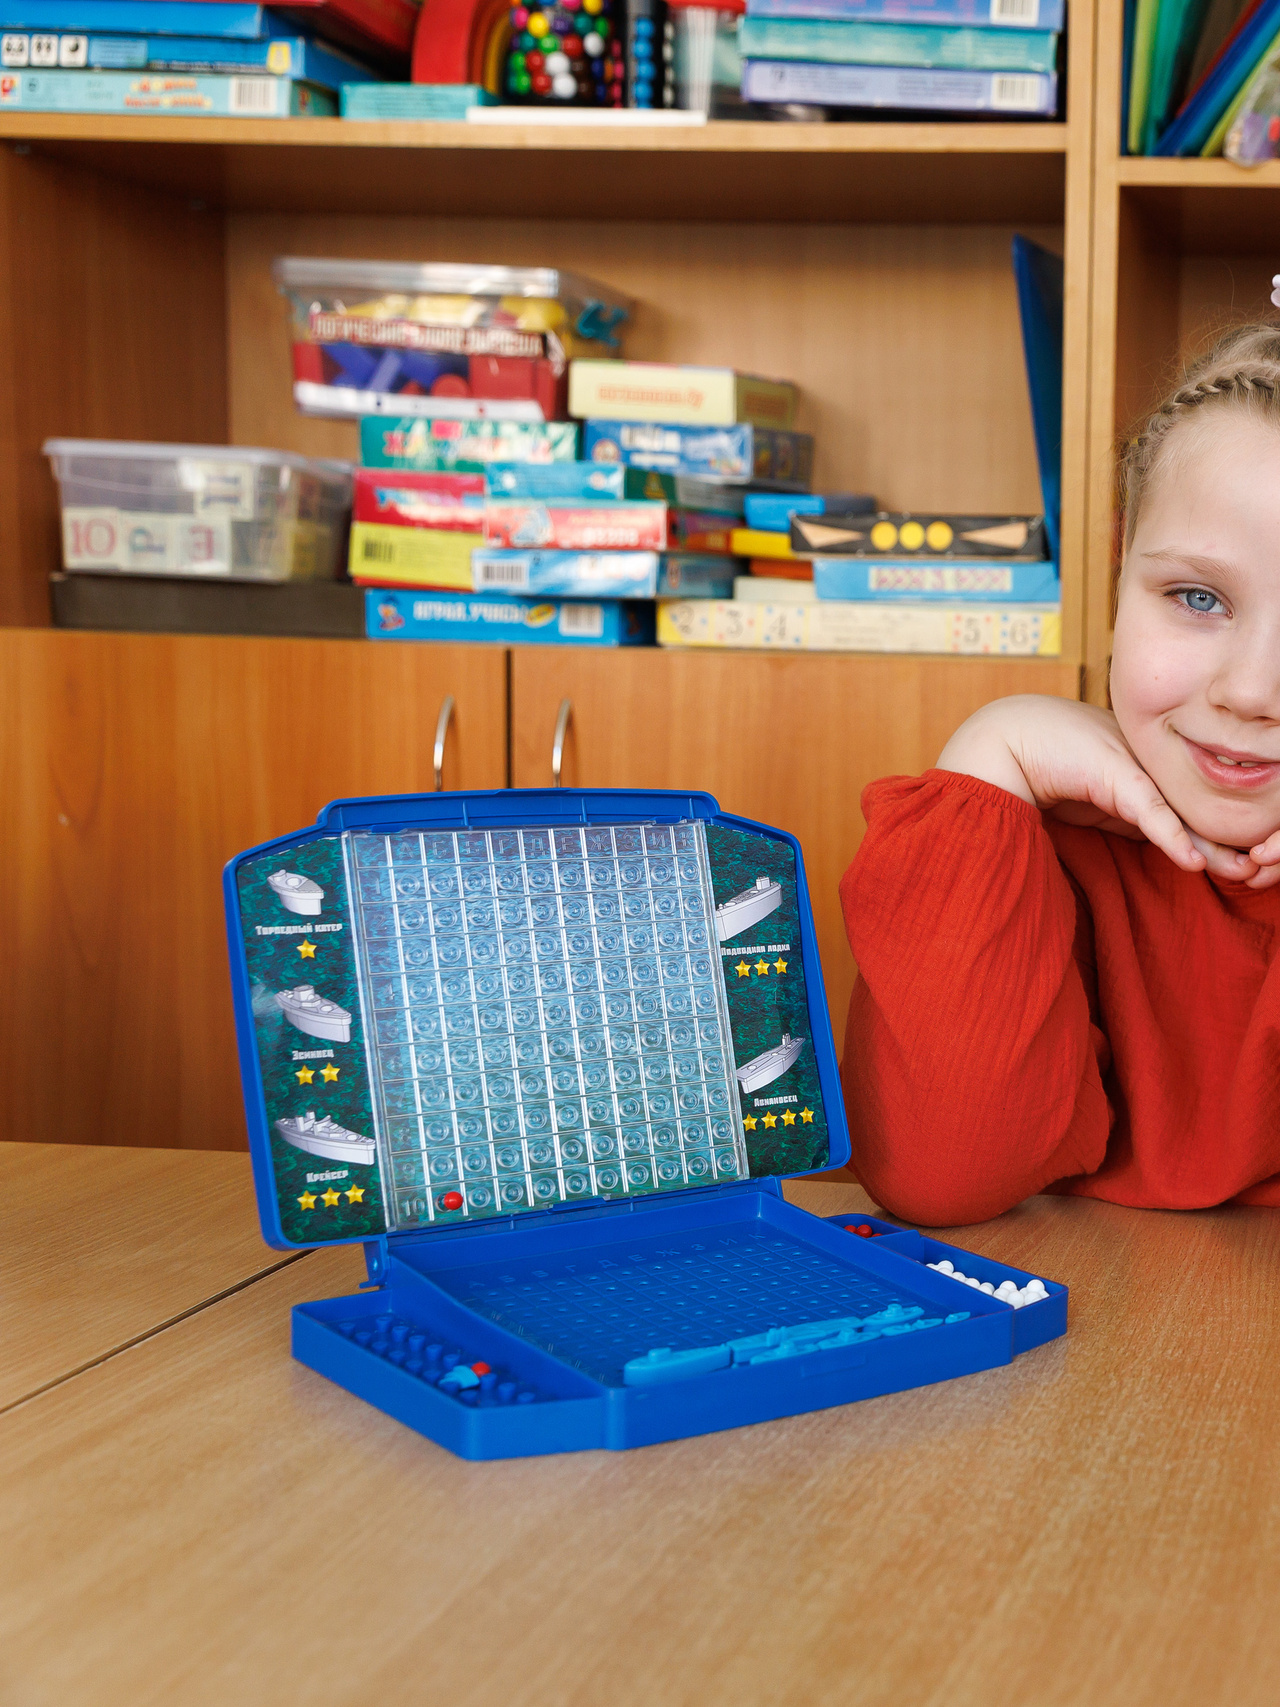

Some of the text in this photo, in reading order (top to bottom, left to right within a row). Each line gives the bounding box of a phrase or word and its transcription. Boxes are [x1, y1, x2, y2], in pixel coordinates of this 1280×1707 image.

[71, 518, 117, 560] 10
[530, 835, 546, 857] Д
[560, 836, 574, 851] Е
[589, 834, 608, 850] Ж
[623, 833, 636, 850] З
[651, 832, 666, 848] И
[678, 831, 694, 848] К
[255, 923, 313, 935] Торпедный
[720, 944, 791, 956] Подводная лодка
[292, 1049, 335, 1060] Эсминец
[754, 1095, 798, 1107] Авианосец
[306, 1169, 349, 1183] Крейсер
